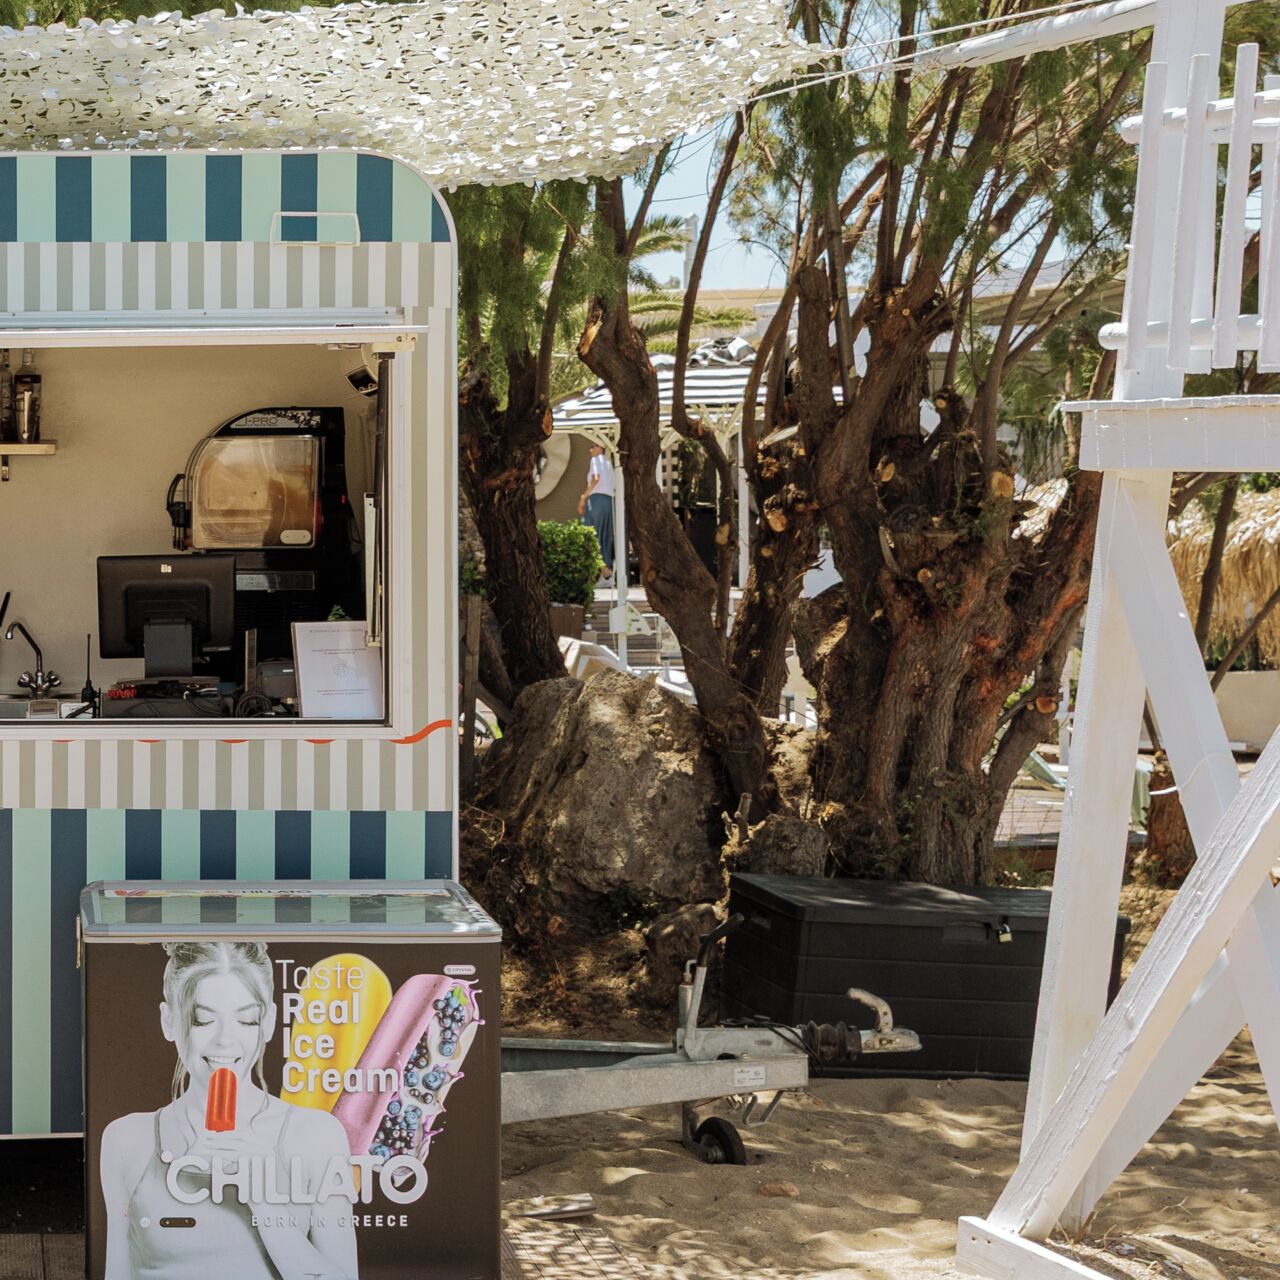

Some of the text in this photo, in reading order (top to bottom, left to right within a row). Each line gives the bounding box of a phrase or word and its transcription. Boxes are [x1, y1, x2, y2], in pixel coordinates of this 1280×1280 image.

[275, 959, 365, 991] Taste
[282, 991, 361, 1025] Real
[282, 1026, 336, 1059] Ice
[282, 1061, 399, 1093] Cream
[165, 1154, 429, 1205] CHILLATO
[251, 1214, 409, 1227] BORN IN GREECE
